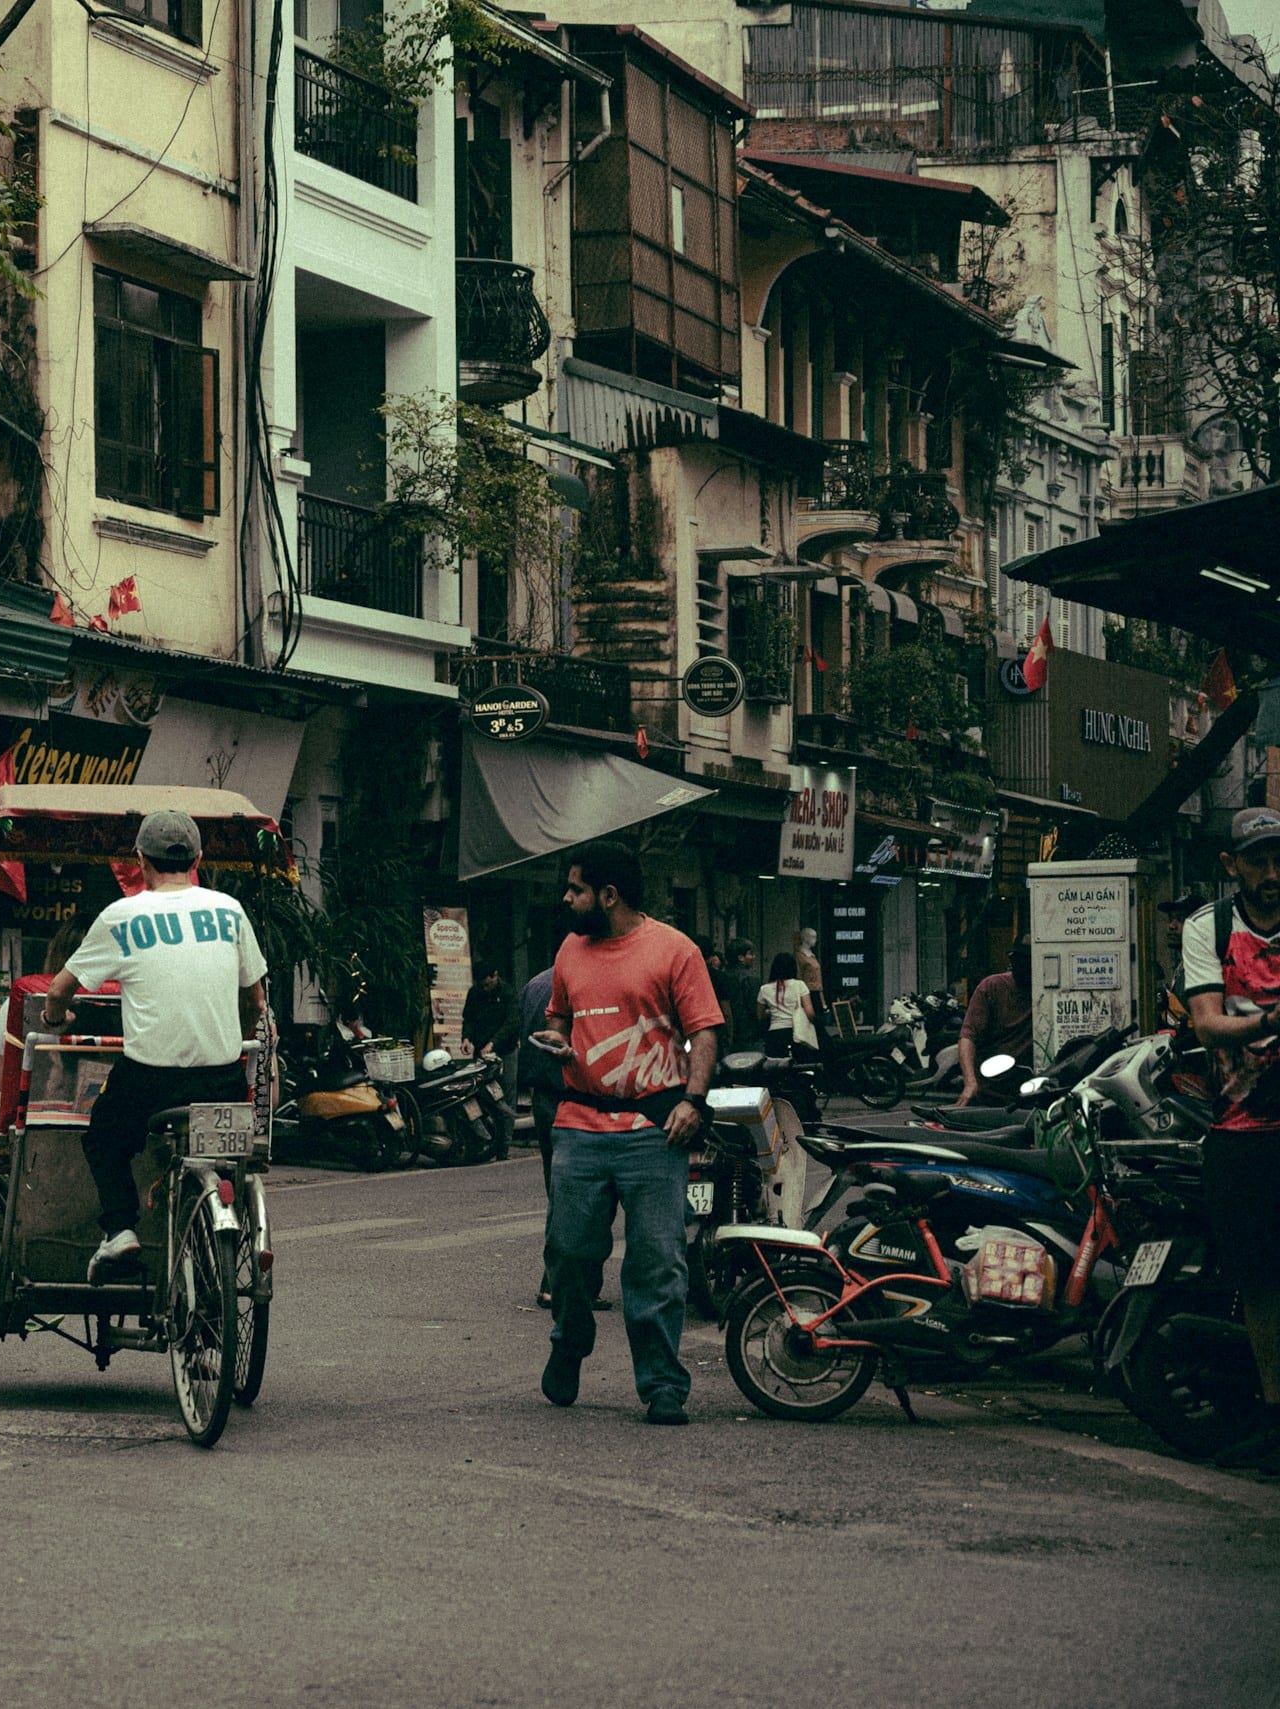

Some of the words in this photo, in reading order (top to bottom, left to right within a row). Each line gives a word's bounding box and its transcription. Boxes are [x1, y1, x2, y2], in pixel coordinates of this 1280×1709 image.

[475, 702, 502, 713] HANOI
[502, 699, 539, 710] GARDEN
[78, 746, 142, 784] world
[822, 790, 849, 830] SHOP
[1080, 891, 1094, 904] LẠI
[110, 912, 183, 957] YOU
[437, 923, 459, 932] Special
[433, 932, 464, 942] Promotion
[1077, 966, 1106, 975] PILLAR
[214, 1108, 233, 1129] 29
[879, 1244, 917, 1261] YAMAHA
